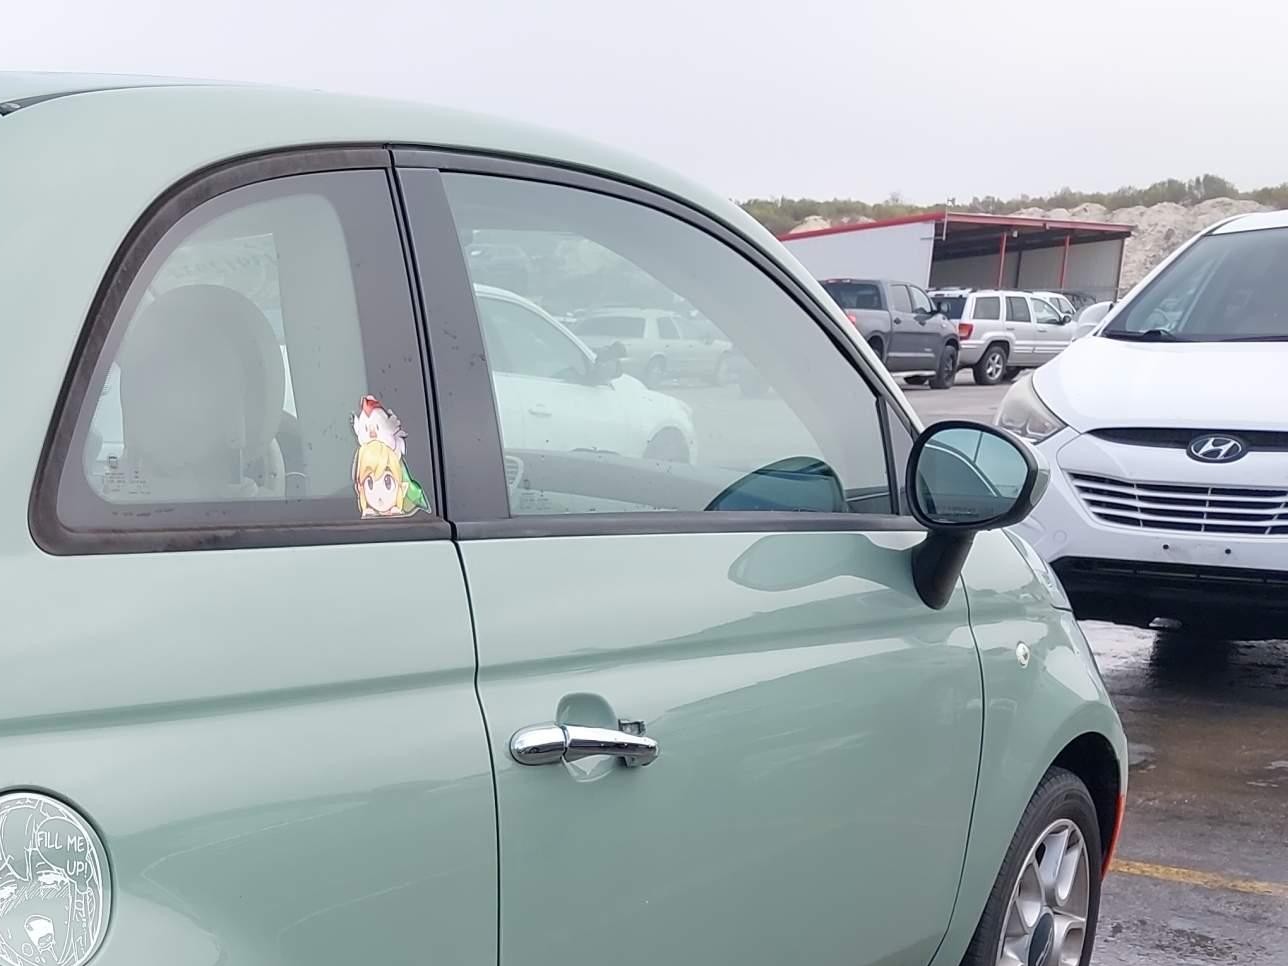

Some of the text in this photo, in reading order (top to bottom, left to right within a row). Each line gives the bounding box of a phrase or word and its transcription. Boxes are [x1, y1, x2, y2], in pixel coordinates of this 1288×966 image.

[37, 830, 86, 853] FILL ME
[66, 859, 88, 879] UP!
